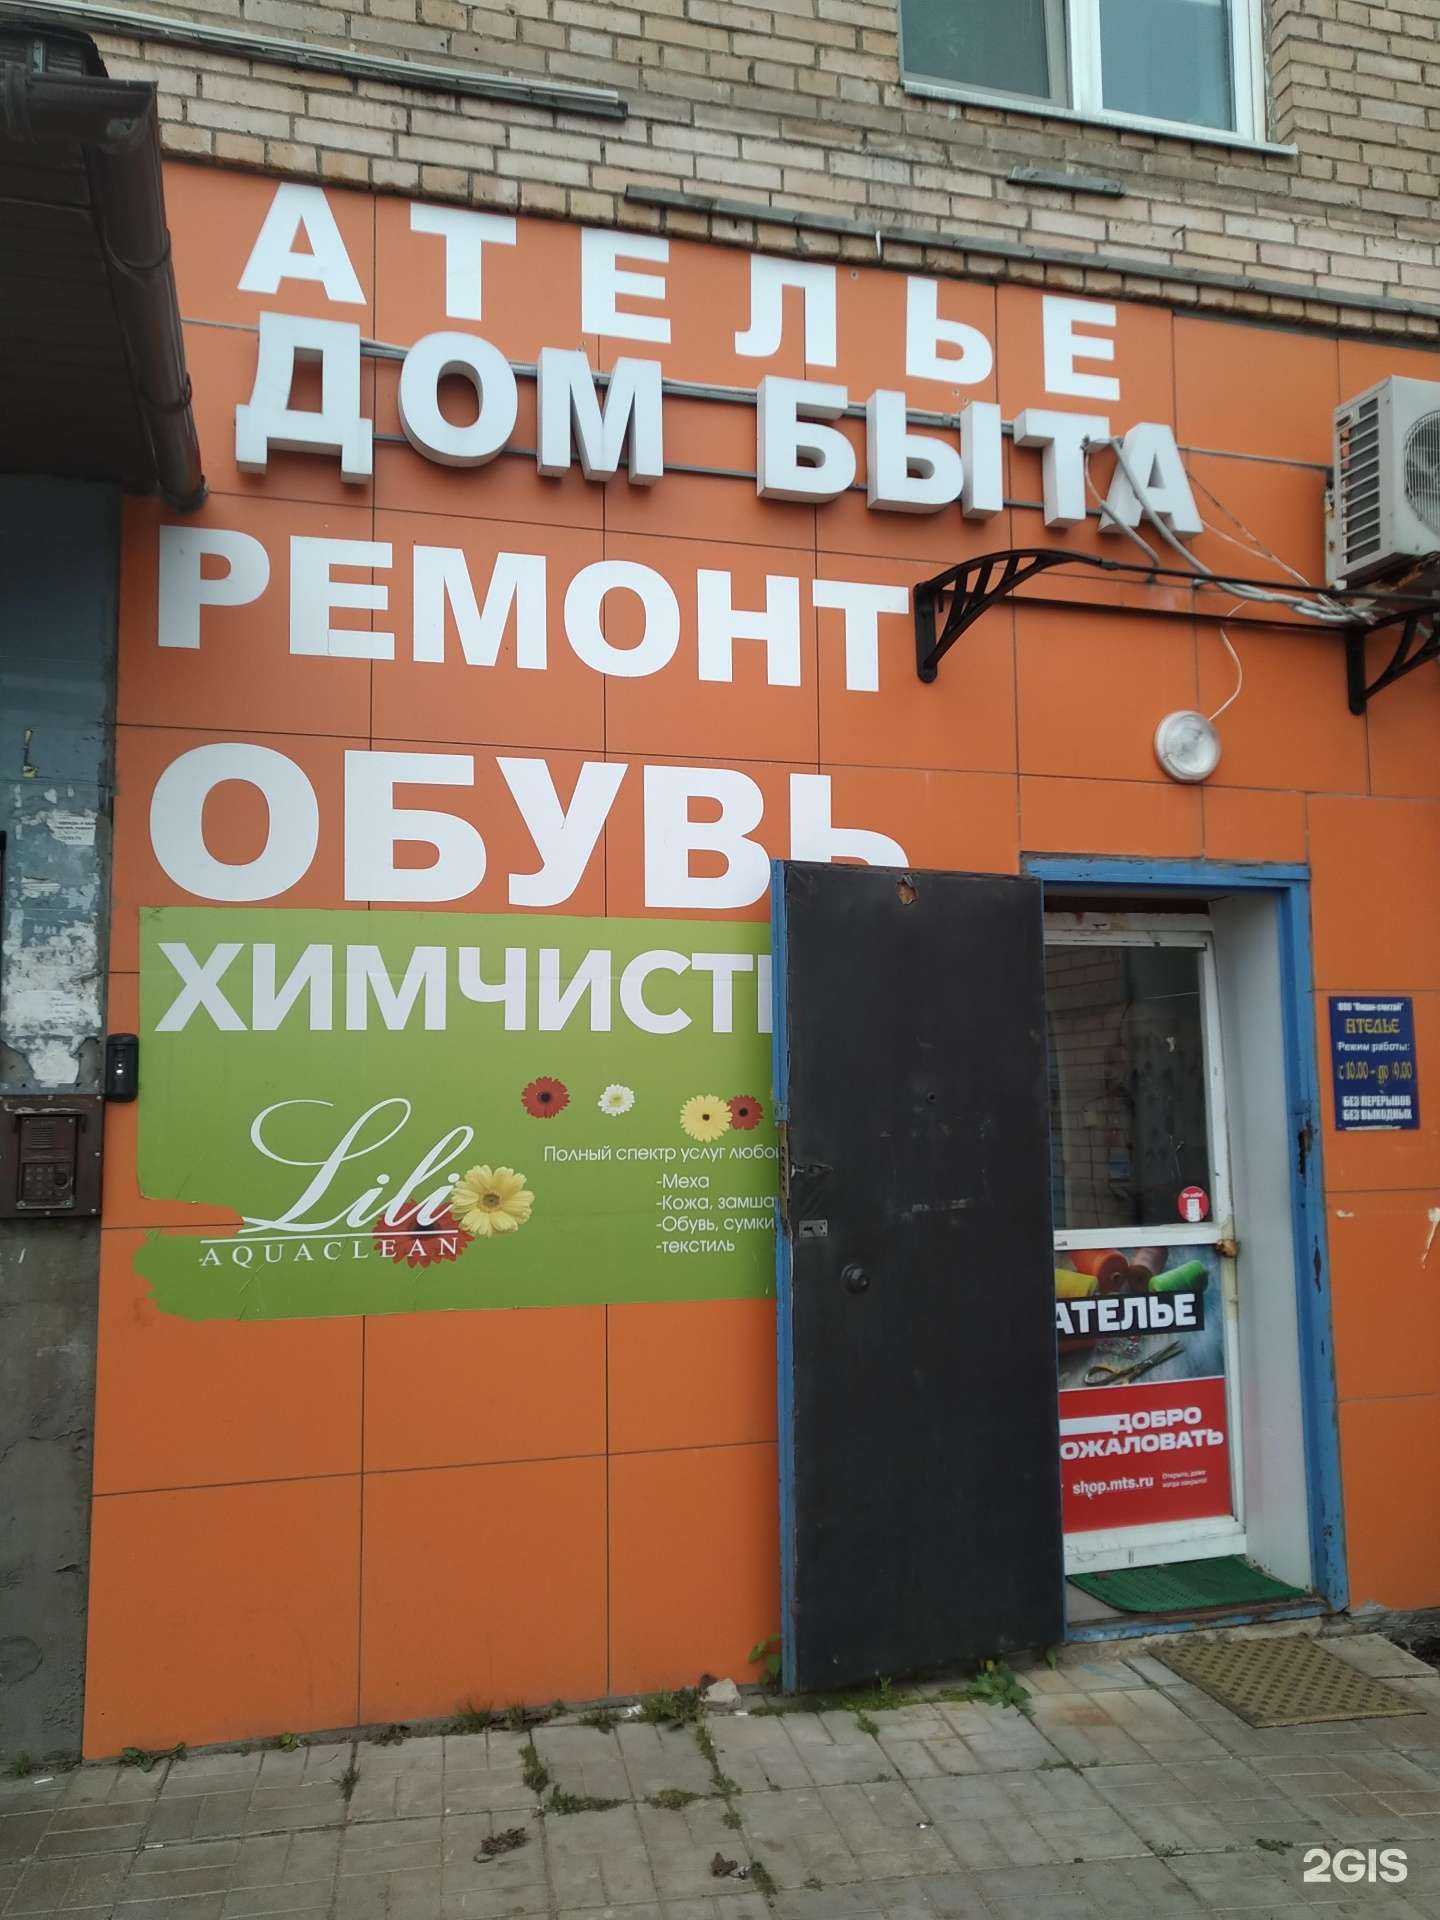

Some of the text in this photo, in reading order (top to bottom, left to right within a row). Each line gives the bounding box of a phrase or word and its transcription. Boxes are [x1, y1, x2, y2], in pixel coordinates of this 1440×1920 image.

[236, 182, 1120, 401] АТЕЛЬЕ
[235, 310, 1203, 537] ДОМ БЫТА
[157, 525, 910, 692] РЕМОНТ
[150, 742, 910, 909] ОБУВЬ
[155, 942, 772, 1034] ХИМЧИСТ
[1345, 1018, 1400, 1034] АТЕЛЬЕ
[1343, 1096, 1359, 1107] БЕЗ
[1343, 1109, 1359, 1121] БЕЗ
[238, 1098, 474, 1233] Lili
[544, 1145, 611, 1161] Полный
[616, 1148, 676, 1163] спектр
[680, 1147, 724, 1163] услуг
[718, 1195, 775, 1209] замша
[201, 1237, 459, 1269] AQUACLEAN
[1056, 1294, 1197, 1334] АТЕЛЬЕ
[1112, 1406, 1202, 1434] ДОБРО
[1060, 1429, 1224, 1460] ОЖАЛОВАТЬ
[1072, 1475, 1154, 1496] shop.mts.ru
